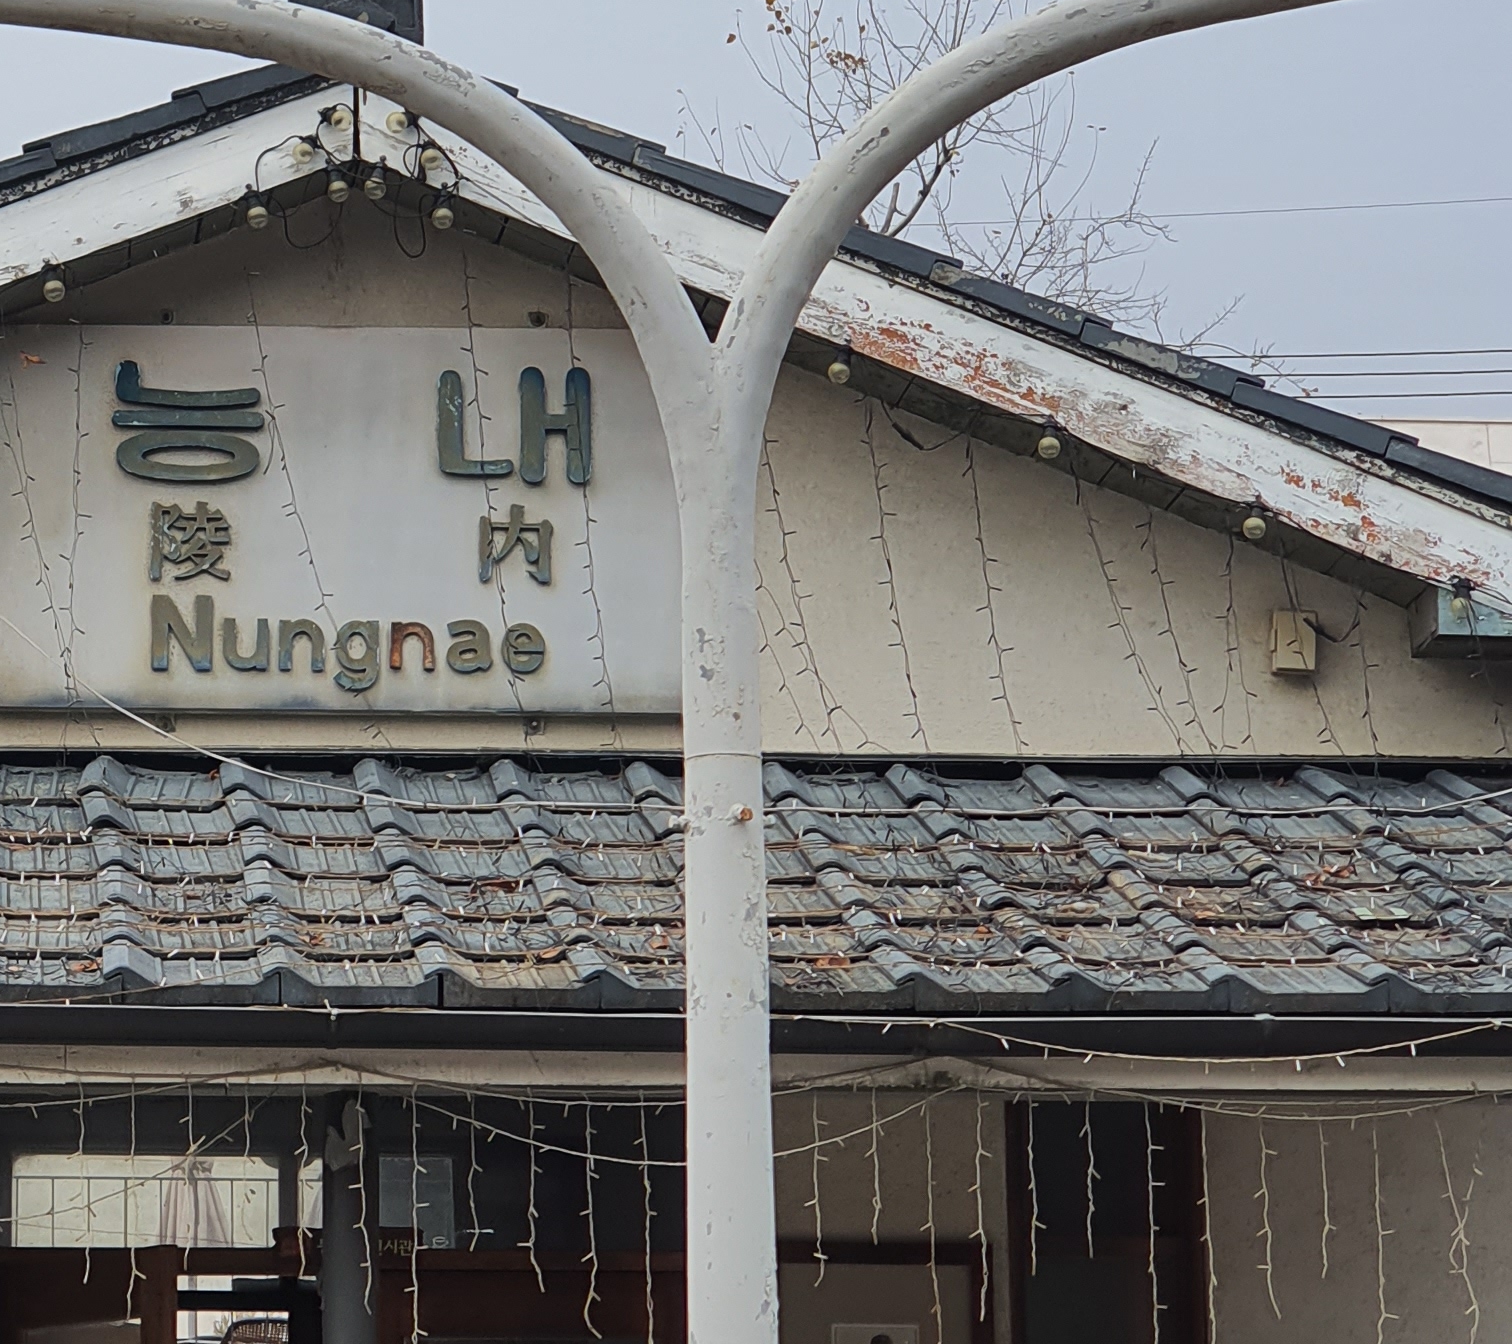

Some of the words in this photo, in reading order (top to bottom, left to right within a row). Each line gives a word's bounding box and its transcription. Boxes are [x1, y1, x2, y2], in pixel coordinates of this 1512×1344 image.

[111, 358, 266, 482] 능
[435, 365, 593, 486] 내
[149, 594, 546, 692] Nungnae
